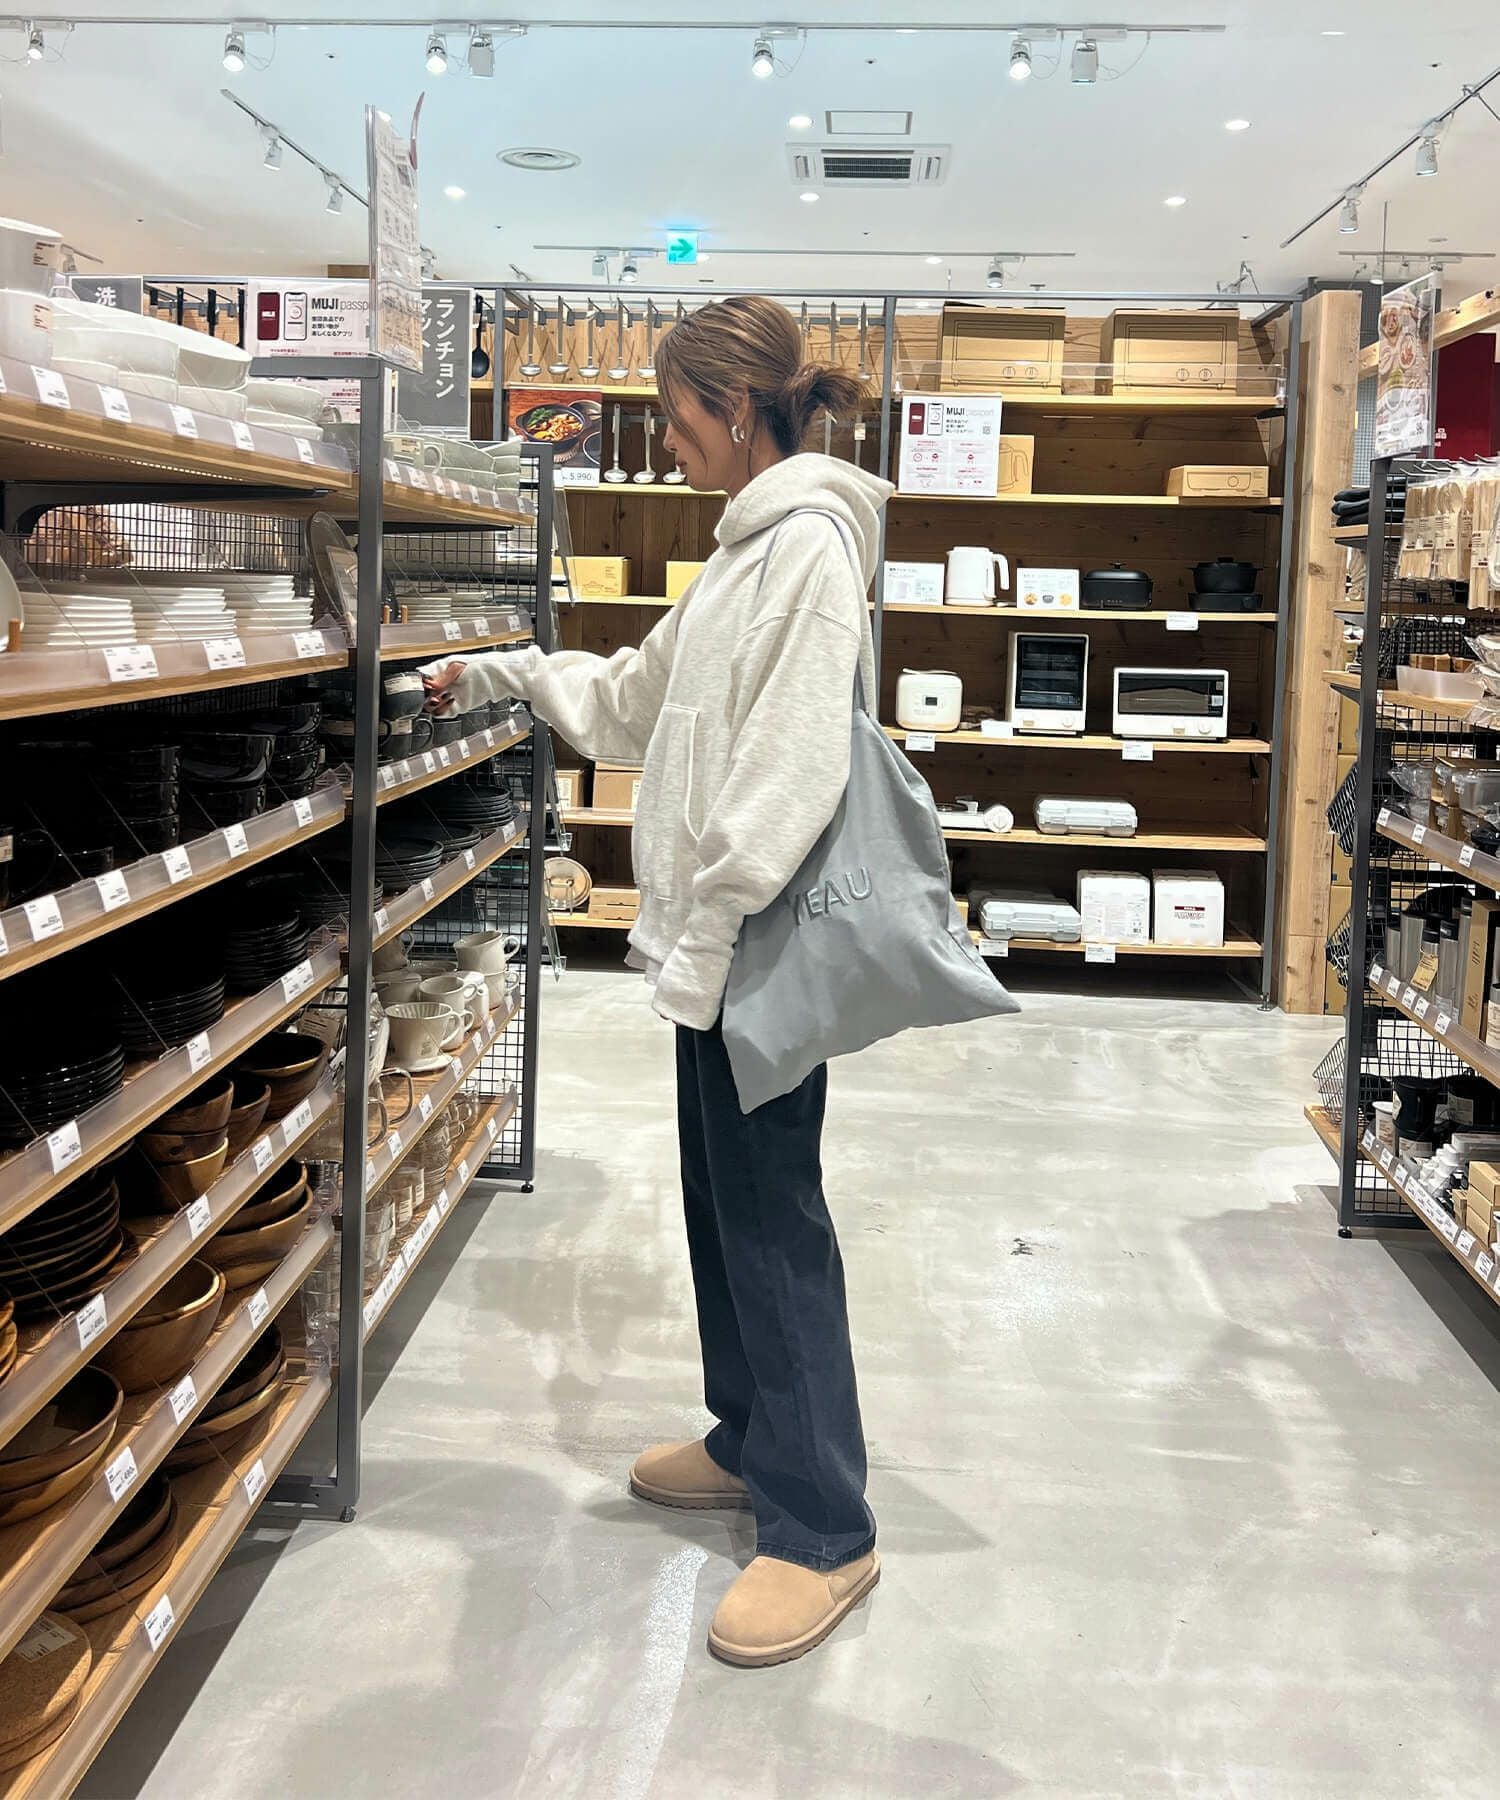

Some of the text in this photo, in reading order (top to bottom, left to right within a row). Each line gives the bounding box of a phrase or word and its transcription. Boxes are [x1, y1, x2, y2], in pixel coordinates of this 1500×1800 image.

[95, 286, 117, 306] 洗
[311, 297, 338, 310] MUJI
[435, 298, 455, 398] ランチョン
[946, 407, 965, 415] MUJI
